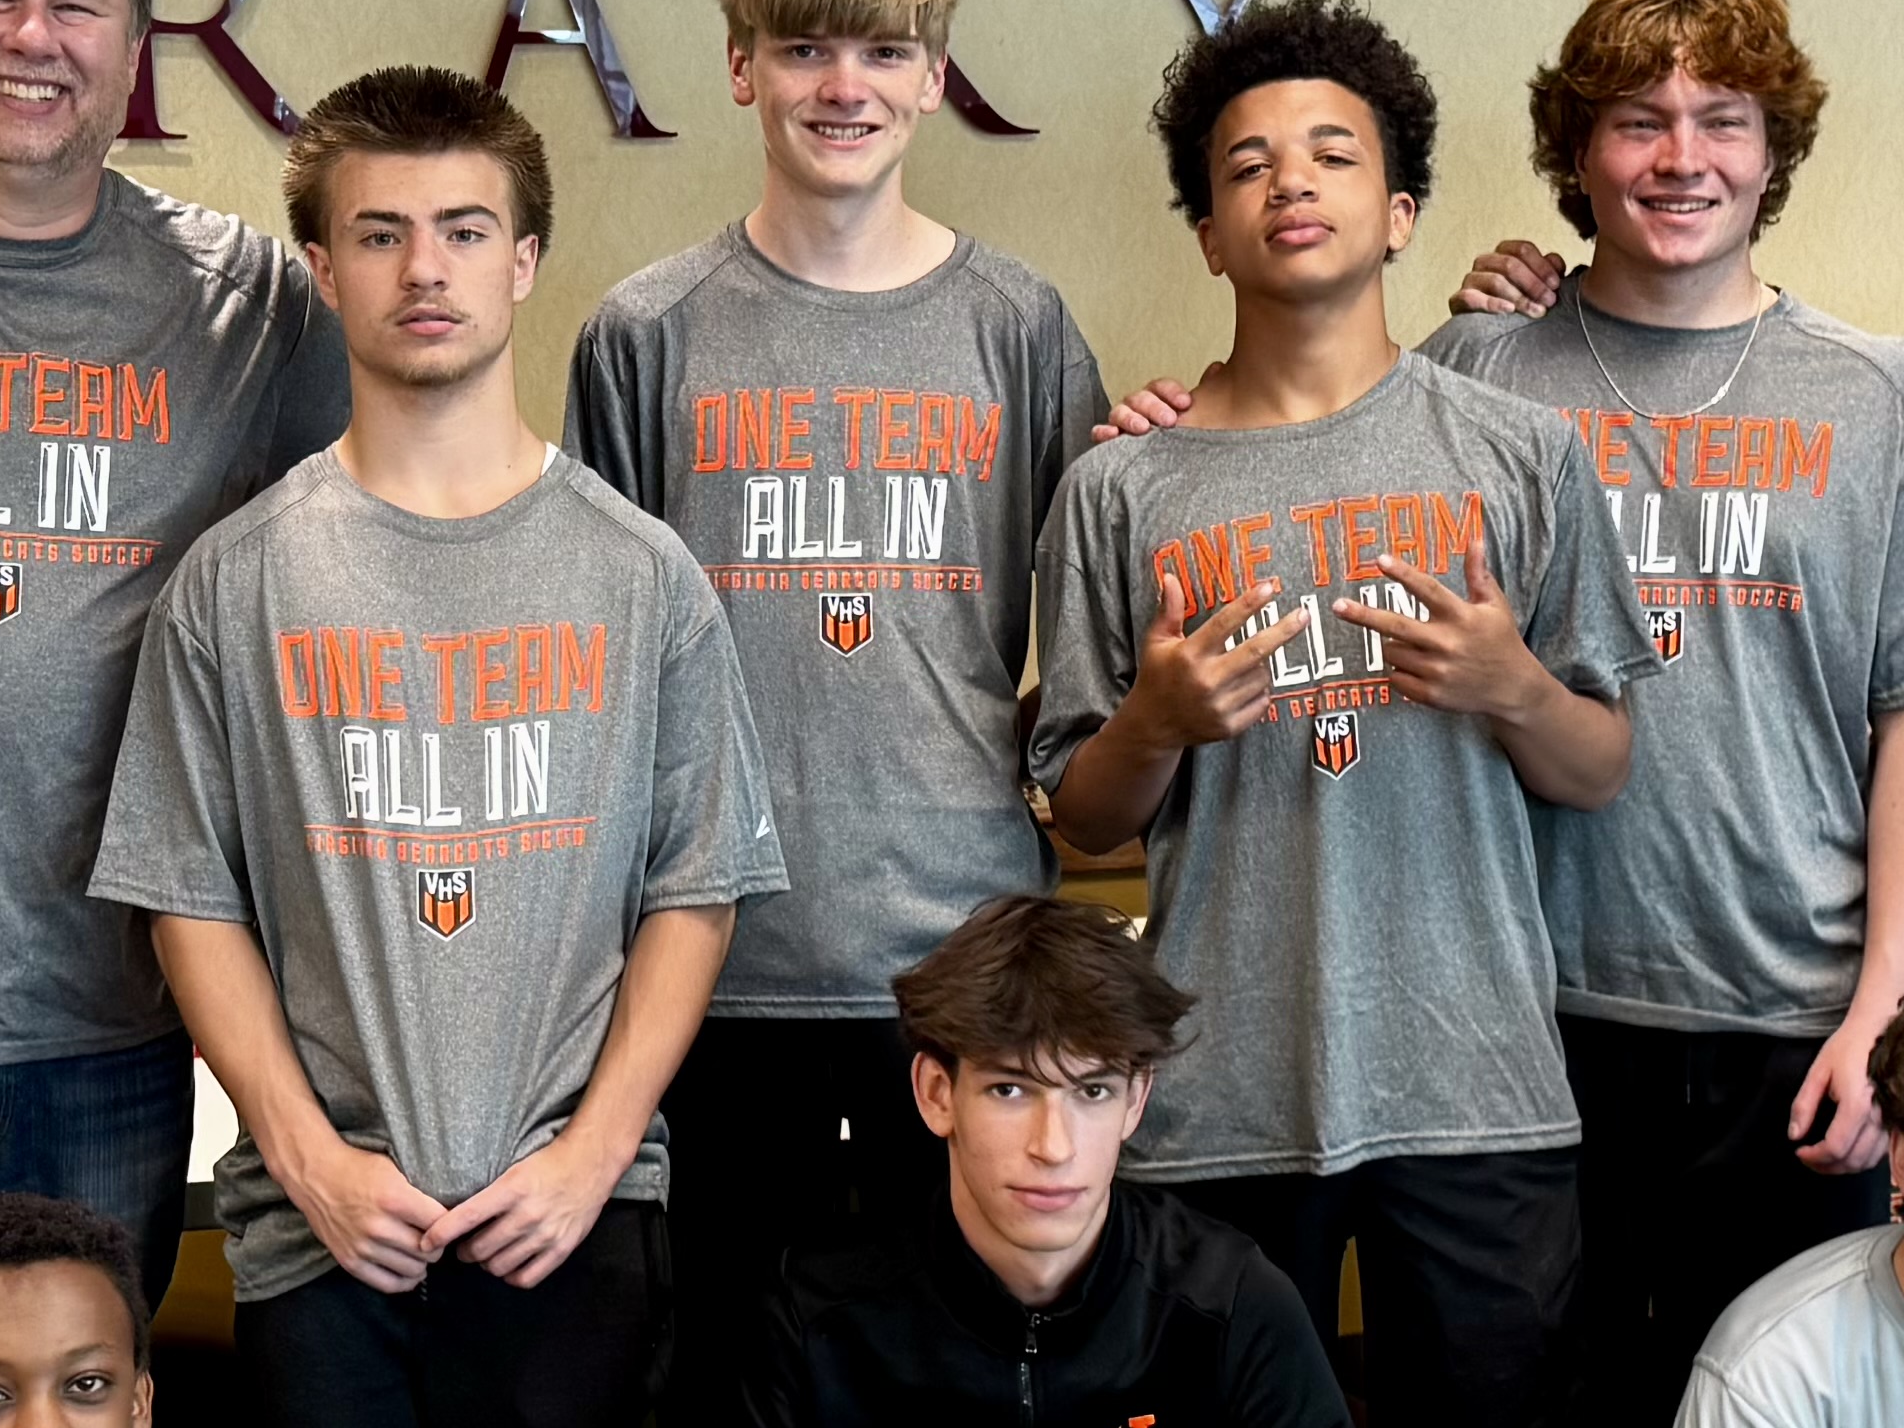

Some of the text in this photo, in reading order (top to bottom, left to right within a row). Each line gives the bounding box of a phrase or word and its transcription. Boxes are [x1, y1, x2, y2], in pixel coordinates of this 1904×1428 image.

[691, 387, 1002, 482] ONE TEAM
[1650, 413, 1834, 498] TEAM
[37, 442, 111, 532] IN
[742, 475, 948, 560] ALL IN
[1290, 490, 1484, 586] TEAM
[1699, 492, 1769, 576] IN
[713, 572, 790, 591] IRGINIA
[827, 596, 865, 622] VHS
[1638, 585, 1718, 606] ARCATS
[277, 621, 607, 724] ONE TEAM
[1314, 715, 1350, 745] VHS
[339, 720, 551, 827] ALL IN
[424, 872, 468, 901] VHS
